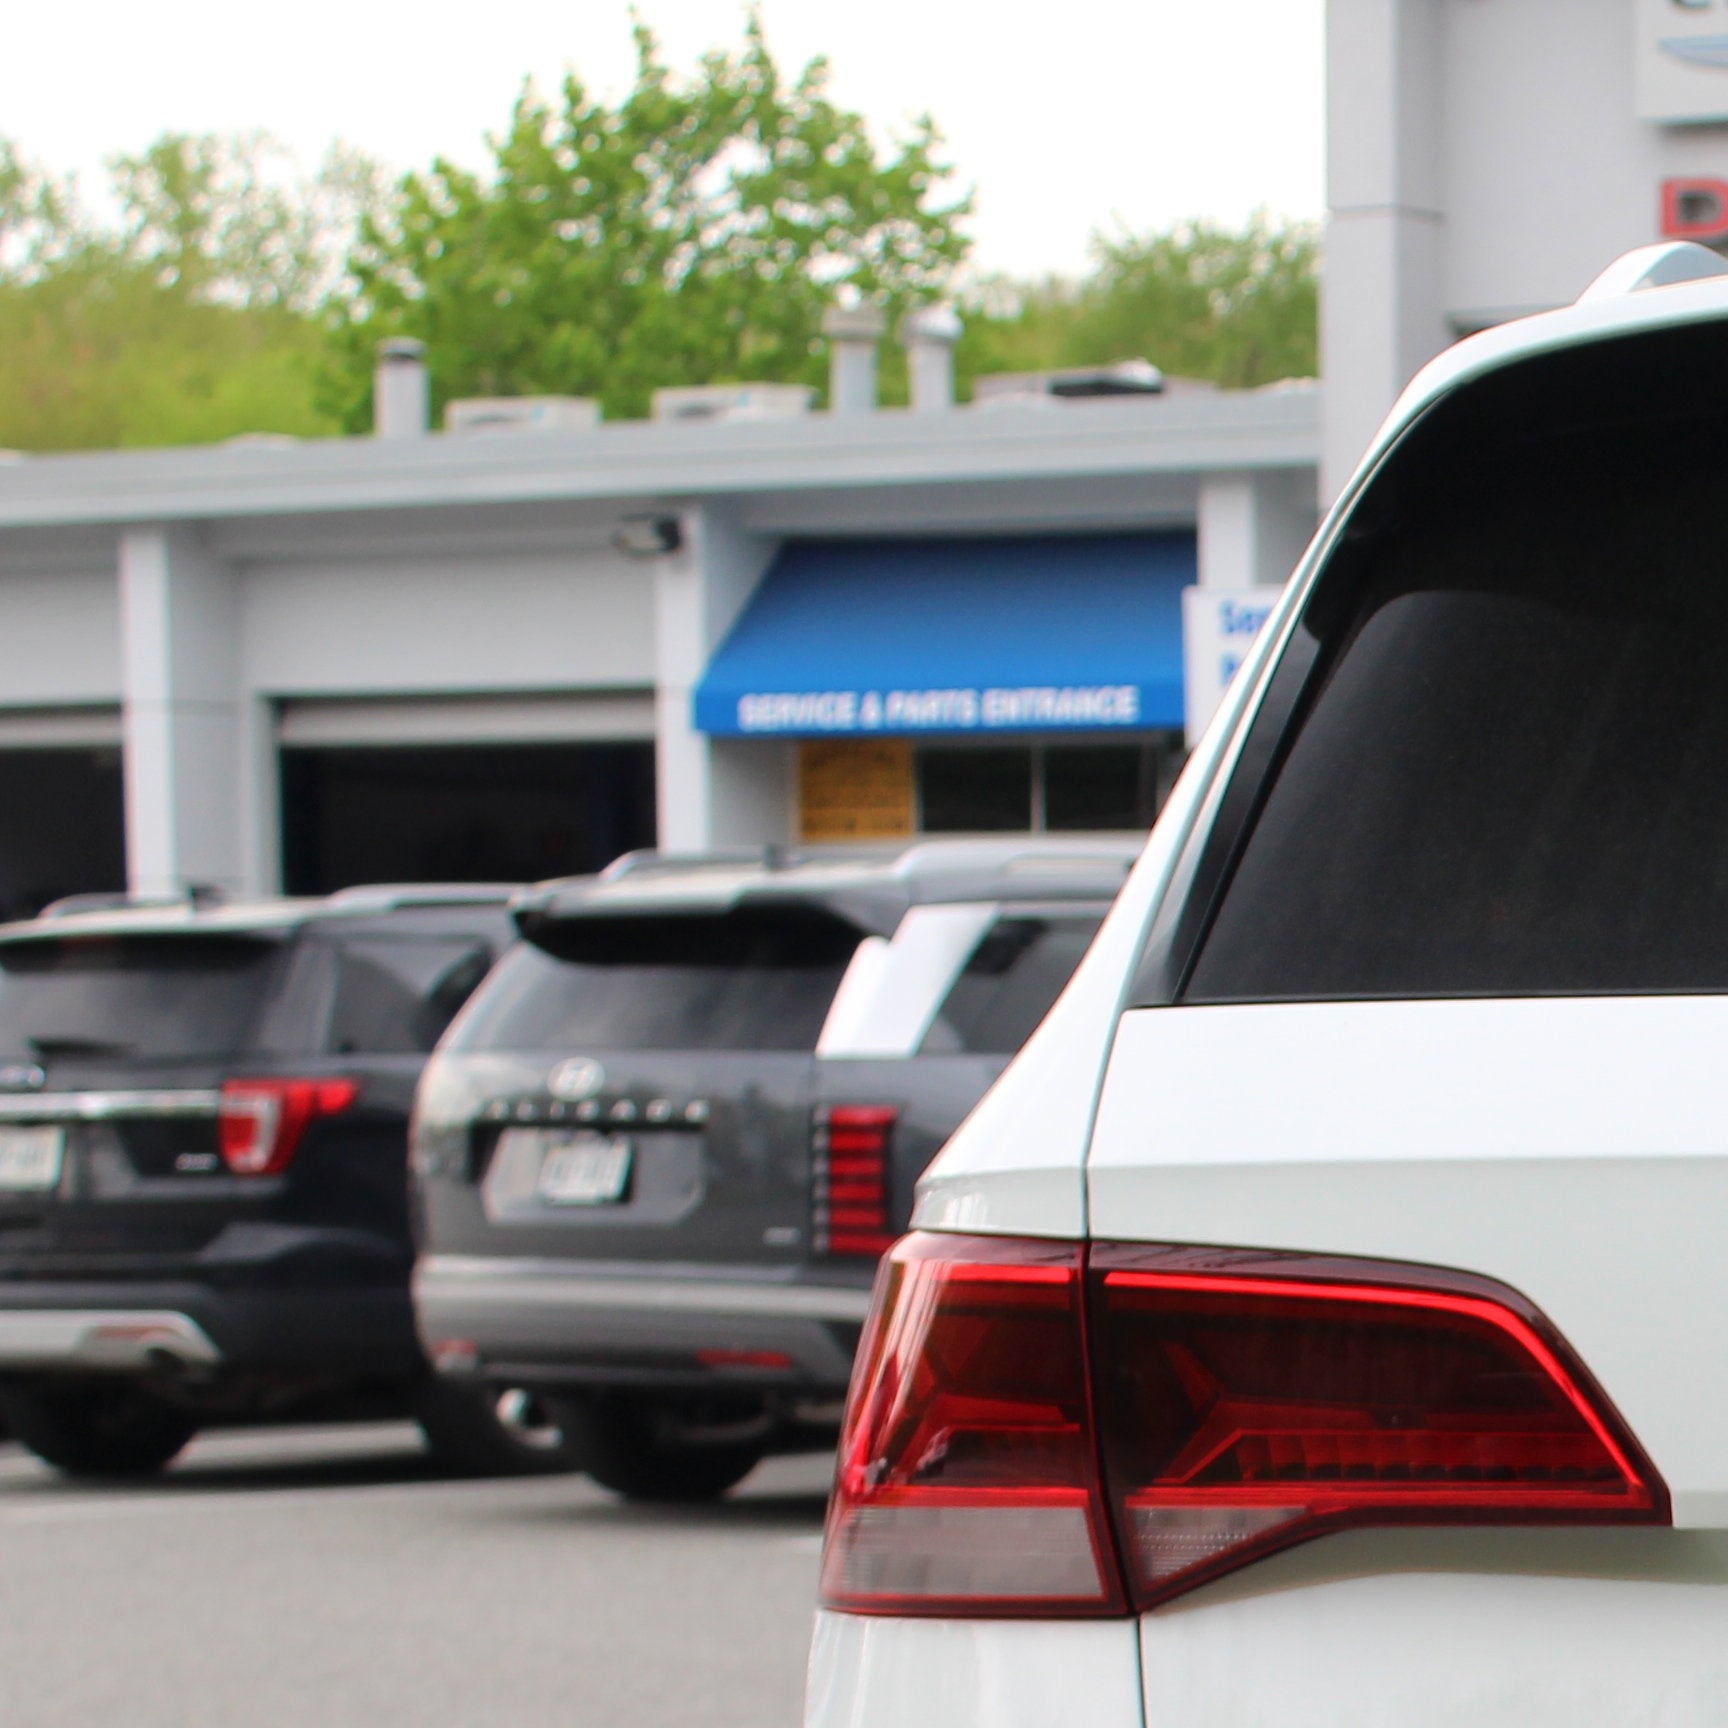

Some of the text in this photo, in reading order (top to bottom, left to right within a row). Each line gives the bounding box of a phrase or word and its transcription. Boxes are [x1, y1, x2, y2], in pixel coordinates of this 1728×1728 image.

[738, 693, 856, 731] SERVICE
[886, 689, 976, 727] PARTS
[983, 685, 1139, 725] ENTRANCE
